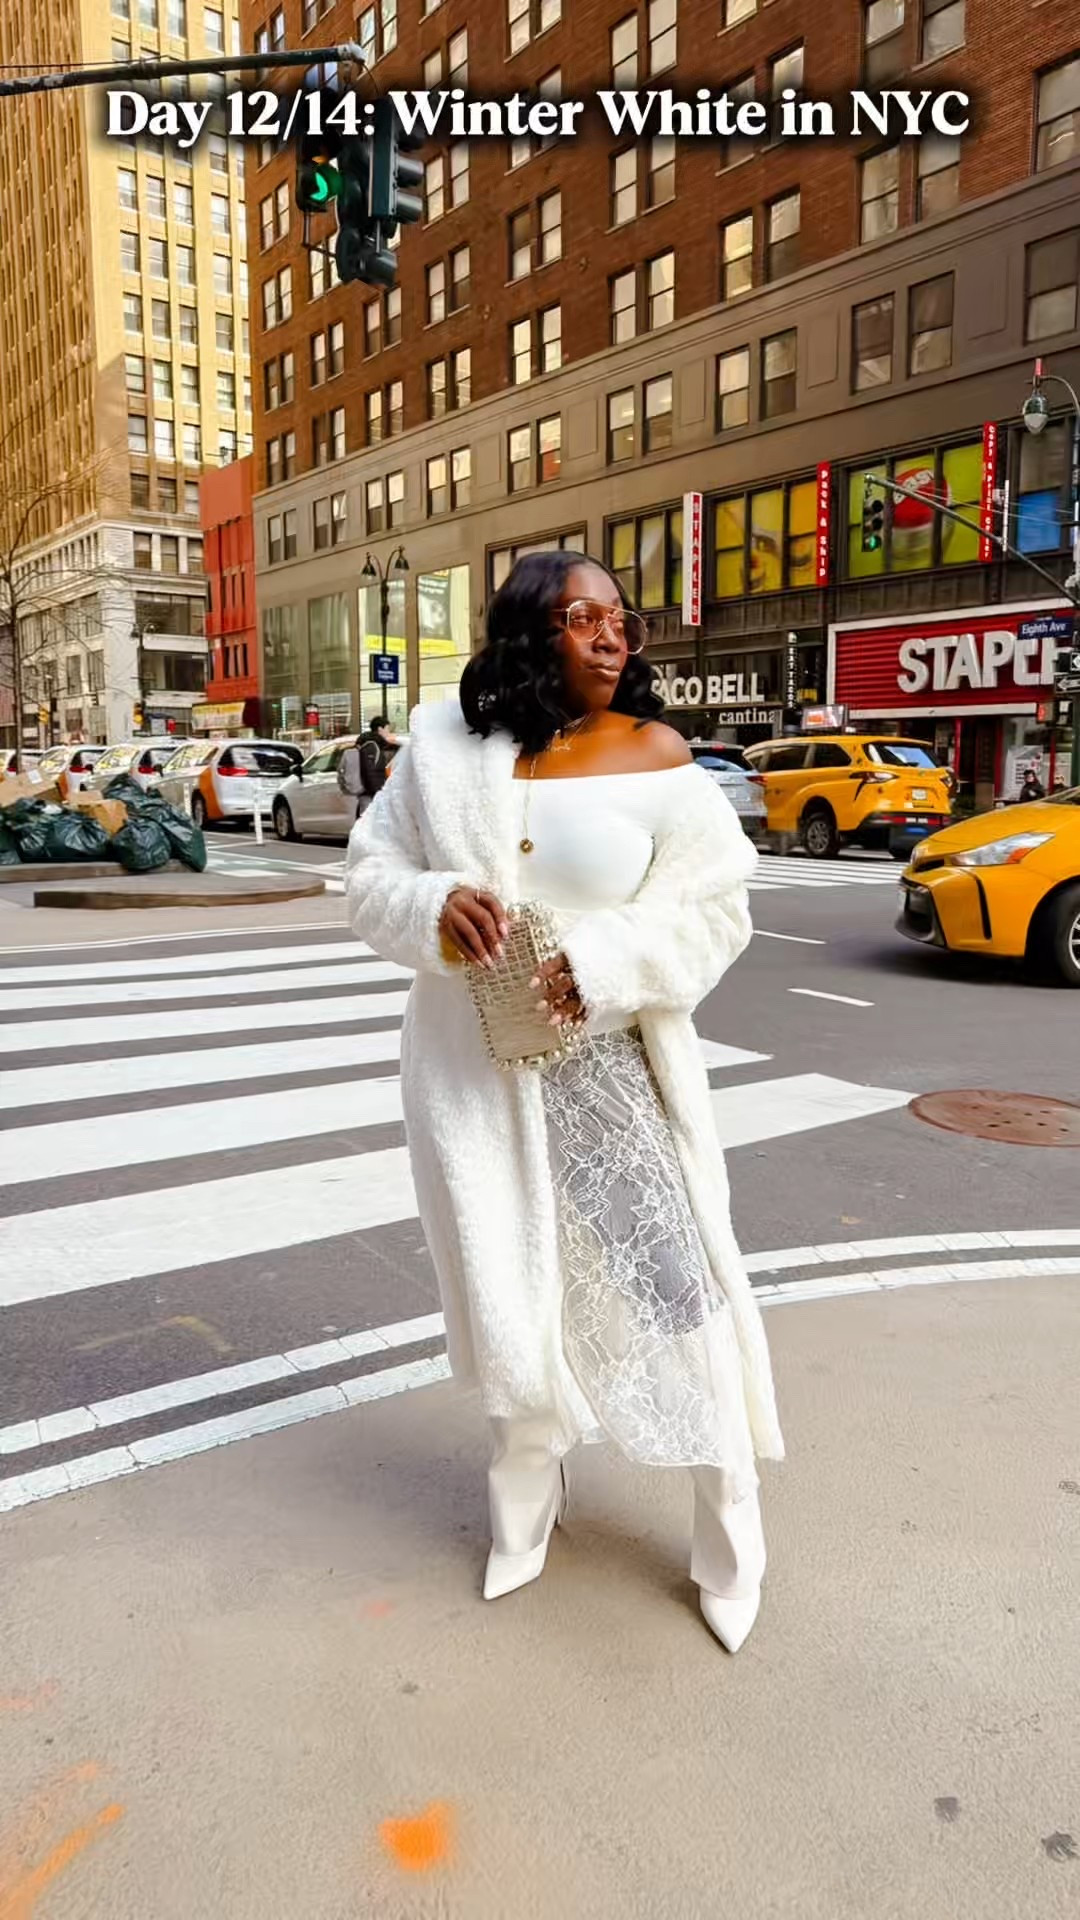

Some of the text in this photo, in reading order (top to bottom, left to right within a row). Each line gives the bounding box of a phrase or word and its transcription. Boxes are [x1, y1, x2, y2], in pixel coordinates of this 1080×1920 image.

[820, 469, 829, 509] Pack
[1022, 621, 1067, 636] Eighth Ave
[651, 672, 765, 705] ACO BELL
